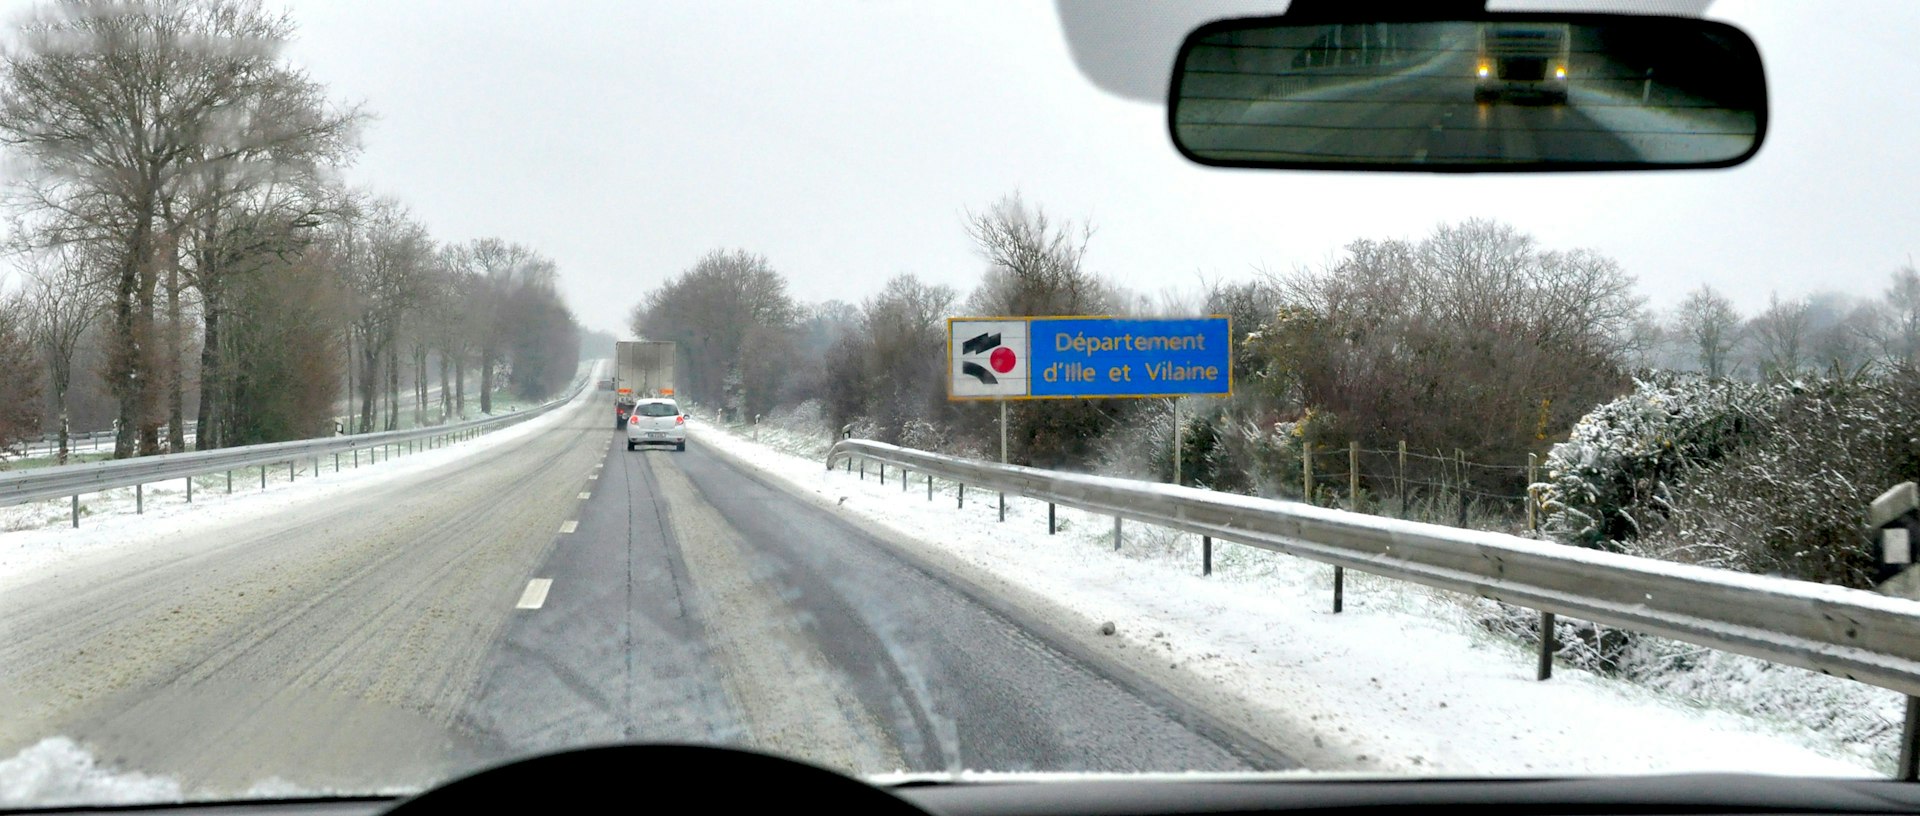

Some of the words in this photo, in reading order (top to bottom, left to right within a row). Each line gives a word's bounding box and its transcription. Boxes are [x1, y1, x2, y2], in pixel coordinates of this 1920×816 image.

[1055, 331, 1206, 357] Département
[1043, 362, 1096, 382] d'Ille
[1108, 364, 1131, 382] et
[1145, 361, 1219, 381] Vilaine
